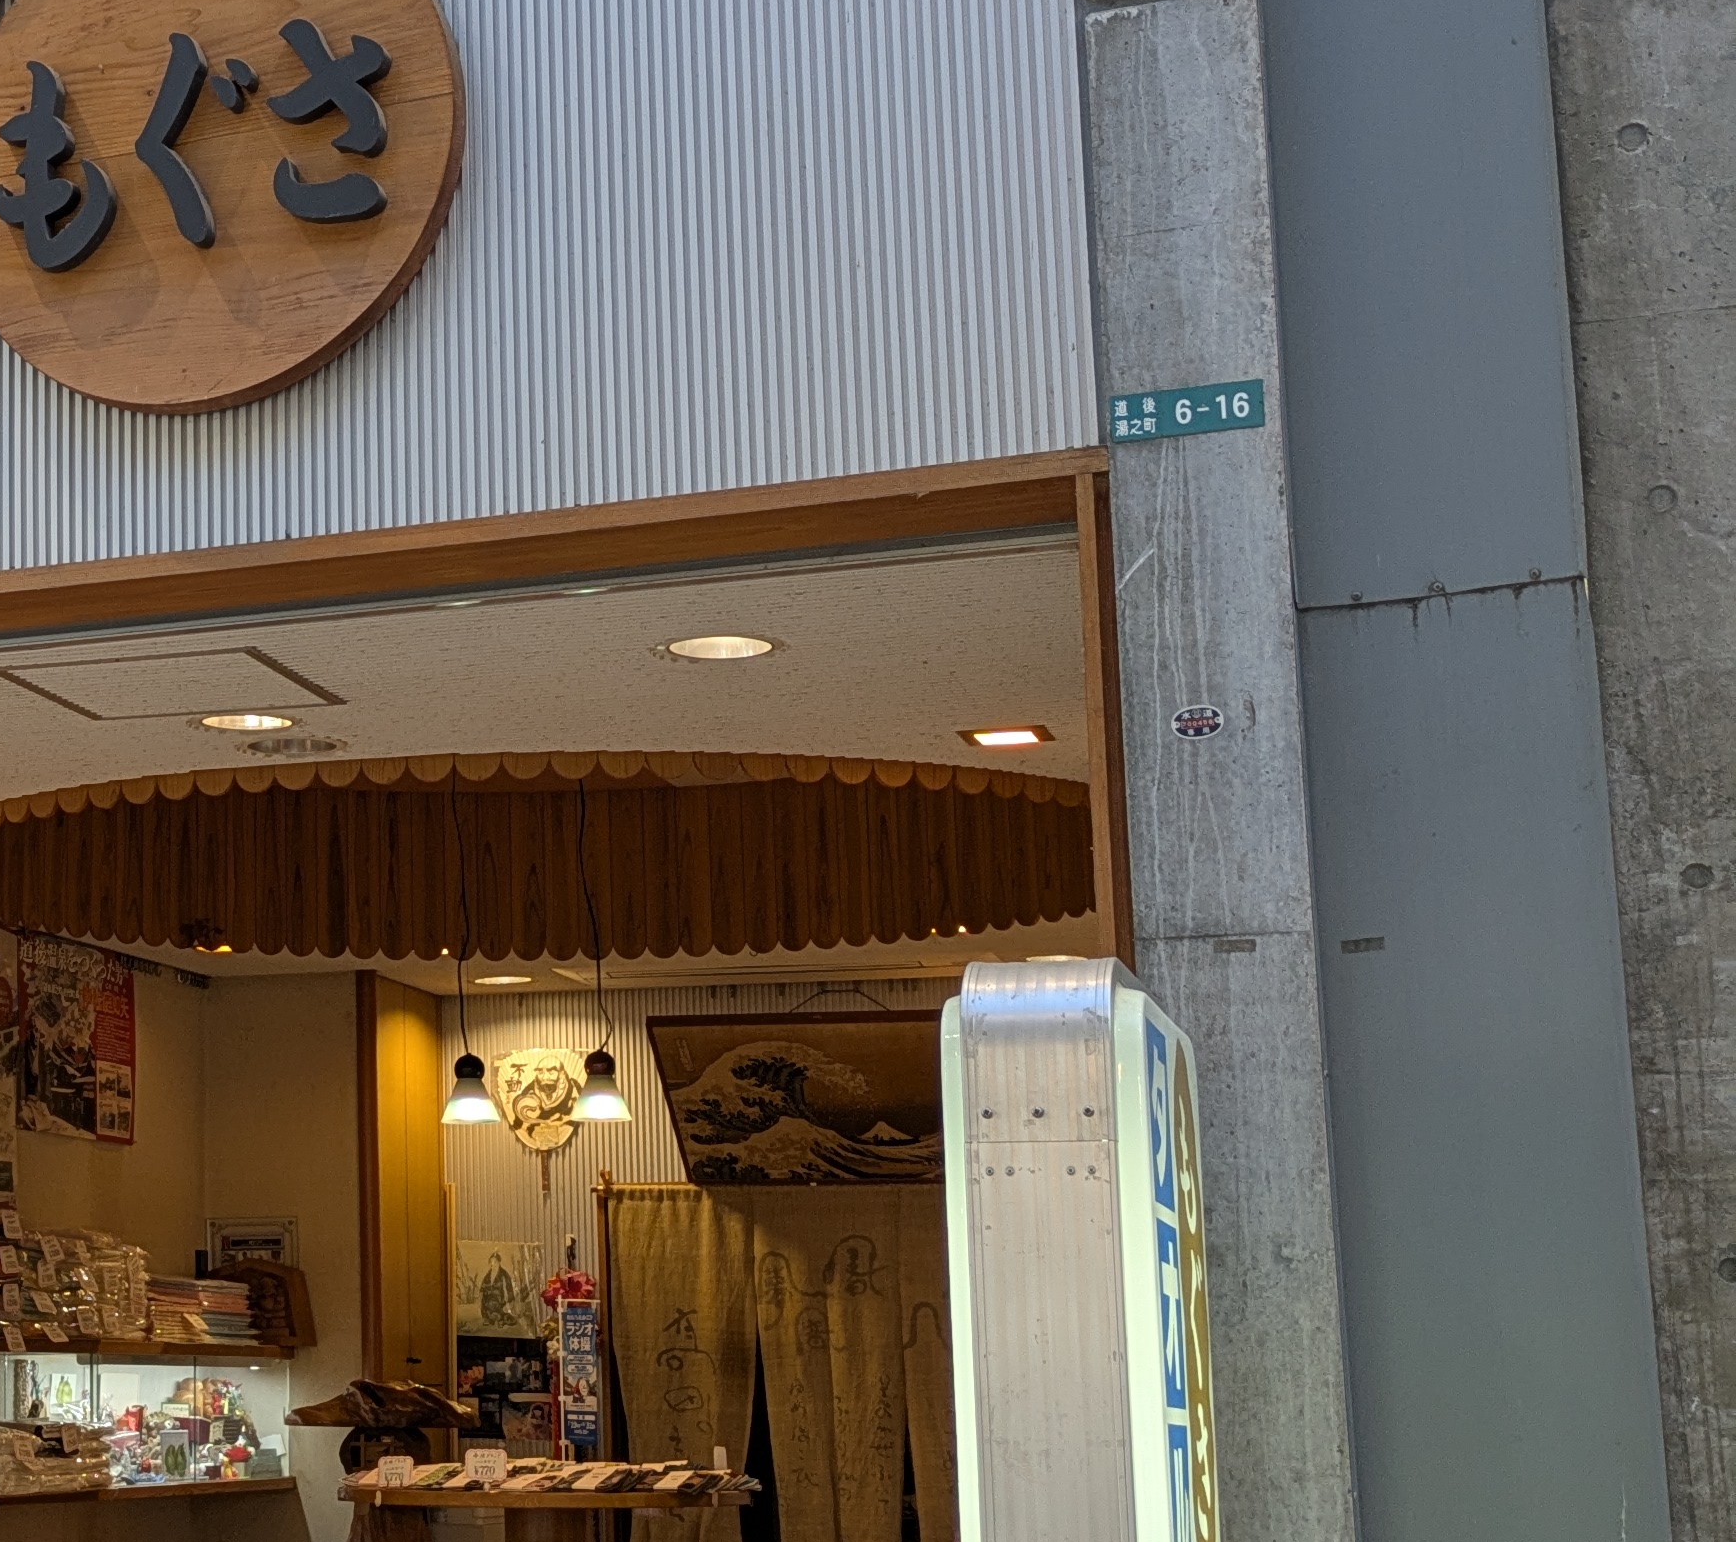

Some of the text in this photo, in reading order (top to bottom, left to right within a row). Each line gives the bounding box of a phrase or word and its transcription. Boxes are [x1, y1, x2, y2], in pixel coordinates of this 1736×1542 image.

[1113, 396, 1157, 418] 道後
[1174, 391, 1251, 425] 6-16
[1114, 417, 1157, 437] 湯之町
[504, 1062, 529, 1094] 不動
[1178, 1094, 1210, 1541] もぐさ
[565, 1321, 594, 1336] ラジオ
[568, 1336, 592, 1353] 体操
[473, 1465, 496, 1476] ¥770
